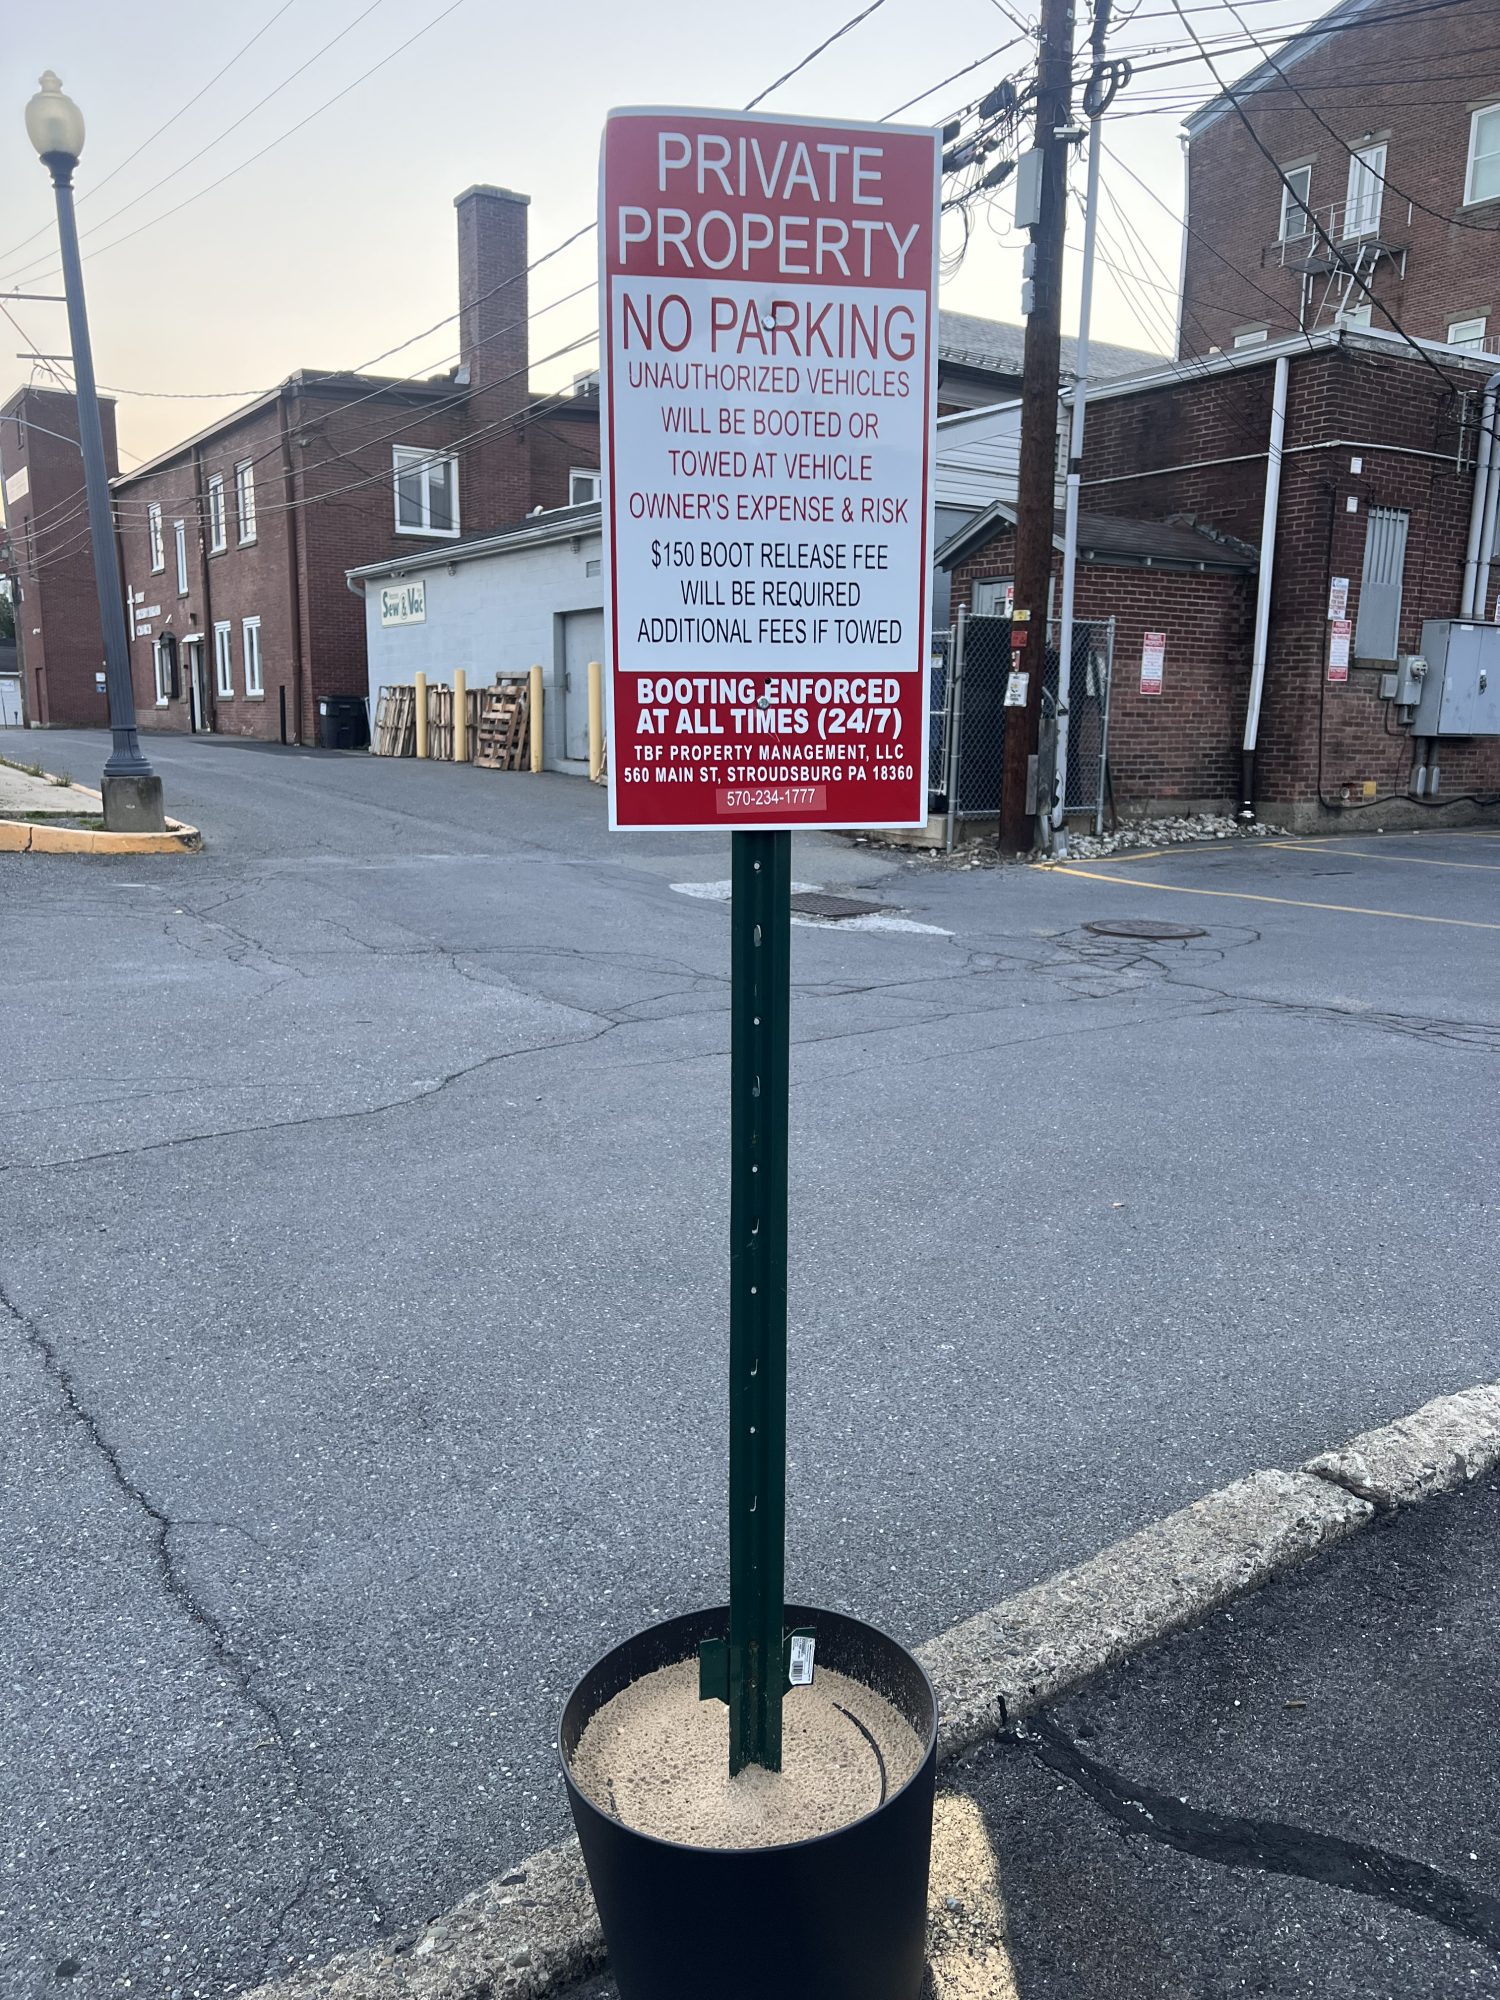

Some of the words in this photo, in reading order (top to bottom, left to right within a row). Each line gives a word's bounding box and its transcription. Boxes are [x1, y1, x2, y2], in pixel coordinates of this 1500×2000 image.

[658, 131, 884, 206] PRIVATE
[618, 205, 920, 279] PROPERTY
[622, 292, 693, 353] NO
[710, 296, 916, 362] PARKING
[628, 361, 801, 394] UNAUTHORIZED
[807, 367, 911, 398] VEHICLES
[661, 406, 712, 434] WILL
[719, 407, 746, 435] BE
[752, 409, 842, 438] BOOTED
[848, 412, 880, 440] OR
[668, 450, 747, 478] TOWED
[752, 452, 778, 479] AT
[783, 453, 873, 481] VEHICLE
[629, 492, 730, 520] OWNER'S
[736, 494, 835, 523] EXPENSE
[841, 497, 854, 523] &
[861, 497, 909, 524] RISK
[651, 539, 695, 569] $150
[700, 541, 755, 568] BOOT
[760, 542, 847, 569] RELEASE
[852, 544, 889, 570] FEE
[382, 590, 400, 618] Sew
[407, 588, 423, 615] Vac
[680, 580, 726, 606] WILL
[731, 580, 756, 606] BE
[762, 581, 861, 608] REQUIRED
[637, 617, 753, 644] ADDITIONAL
[758, 618, 807, 644] FEES
[812, 619, 829, 644] IF
[833, 619, 903, 645] TOWED
[636, 678, 757, 705] BOOTING
[763, 677, 901, 705] ENFORCED
[635, 708, 670, 734] AT
[674, 708, 725, 734] ALL
[730, 708, 810, 734] TIMES
[816, 707, 903, 740] (24/7)
[634, 745, 664, 762] TBF
[669, 744, 753, 762] PROPERTY
[758, 744, 870, 762] MANAGEMENT,
[875, 743, 905, 760] LLC
[623, 767, 651, 783] 560
[655, 767, 695, 783] MAIN
[699, 767, 722, 785] ST,
[726, 766, 843, 782] STROUDSBURG
[848, 766, 867, 781] PA
[872, 765, 914, 781] 18360
[726, 787, 816, 808] 570-234-1777
